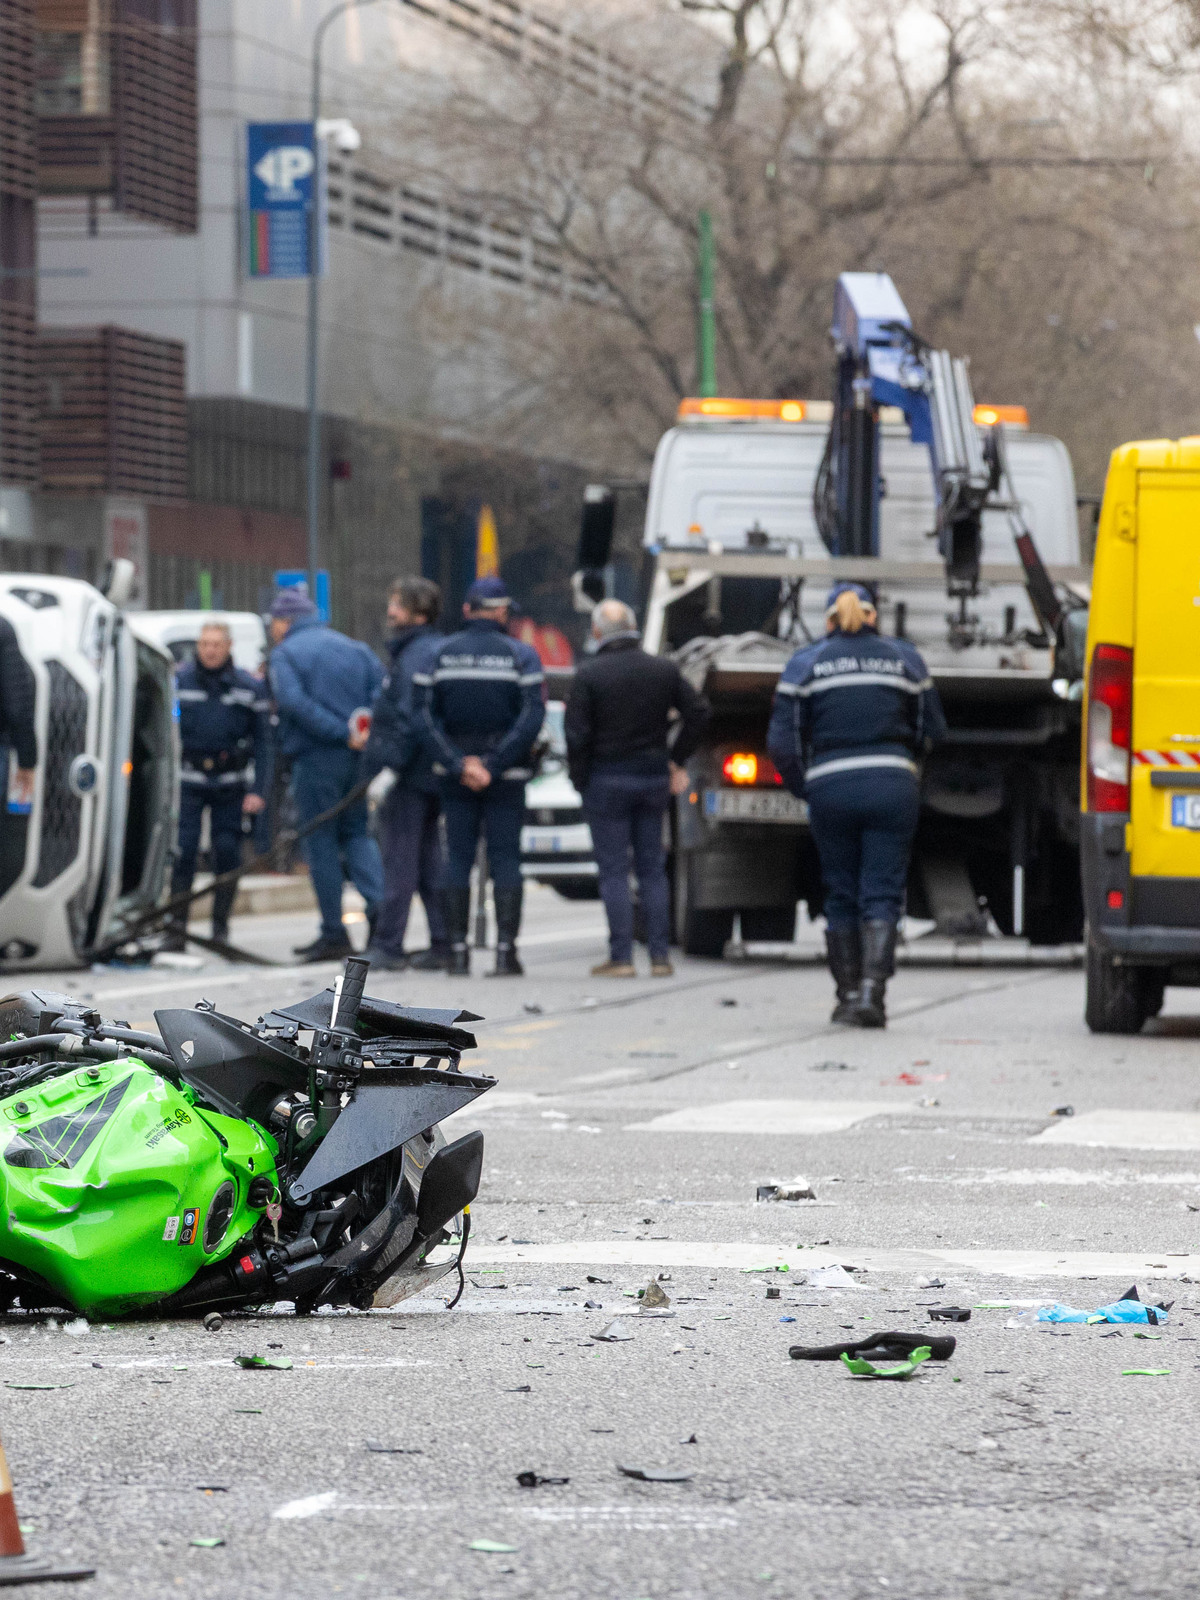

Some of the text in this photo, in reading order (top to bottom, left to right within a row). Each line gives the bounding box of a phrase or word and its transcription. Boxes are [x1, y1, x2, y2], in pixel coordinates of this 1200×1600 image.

[280, 146, 314, 190] P
[813, 656, 905, 677] POLIZIA LOCALE
[145, 1117, 172, 1139] Racing Team
[146, 1119, 183, 1149] Kawasaki
